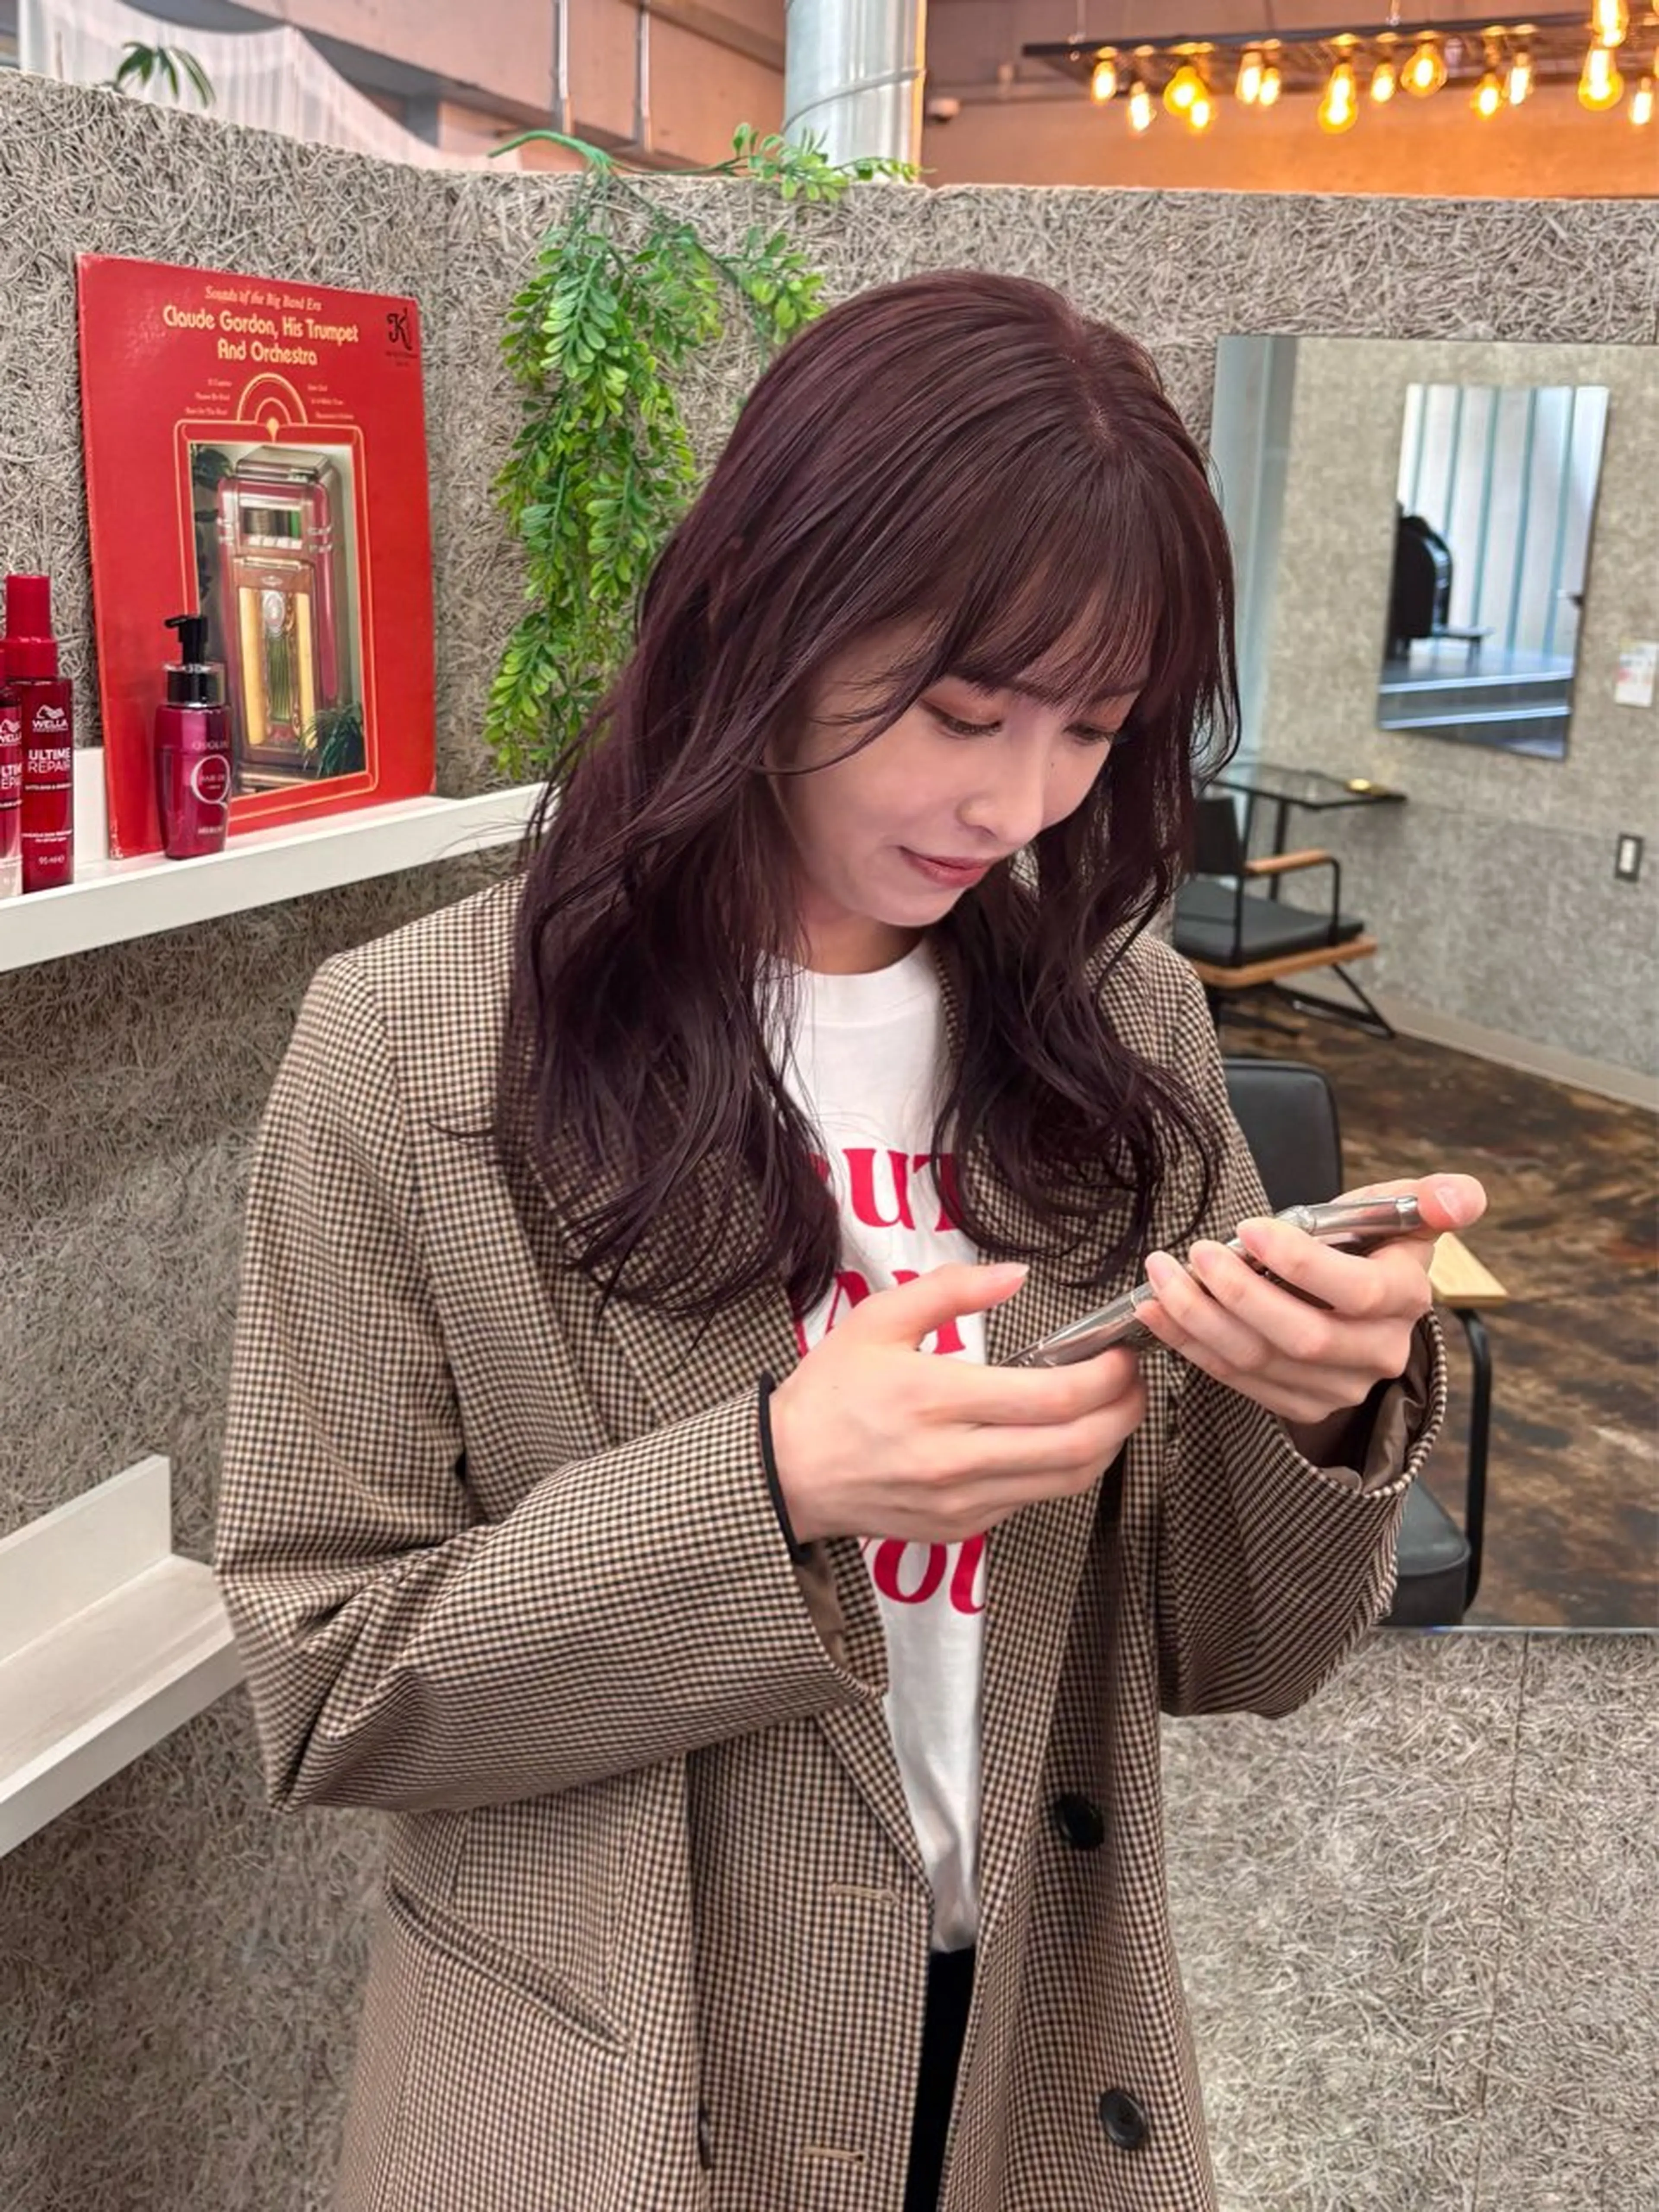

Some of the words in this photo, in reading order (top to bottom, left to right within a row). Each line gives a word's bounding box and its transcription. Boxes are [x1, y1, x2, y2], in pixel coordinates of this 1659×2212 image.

[239, 290, 249, 305] of
[250, 290, 264, 305] the
[266, 292, 281, 309] Big
[282, 294, 304, 310] Band
[306, 297, 322, 311] Era
[163, 305, 216, 329] Claude
[219, 310, 278, 339] Gordon,
[282, 315, 303, 338] His
[305, 318, 359, 346] Trumpet
[217, 337, 246, 360] And
[250, 340, 318, 365] Orchestra
[32, 719, 68, 728] WELLA
[28, 747, 71, 760] ULTIME
